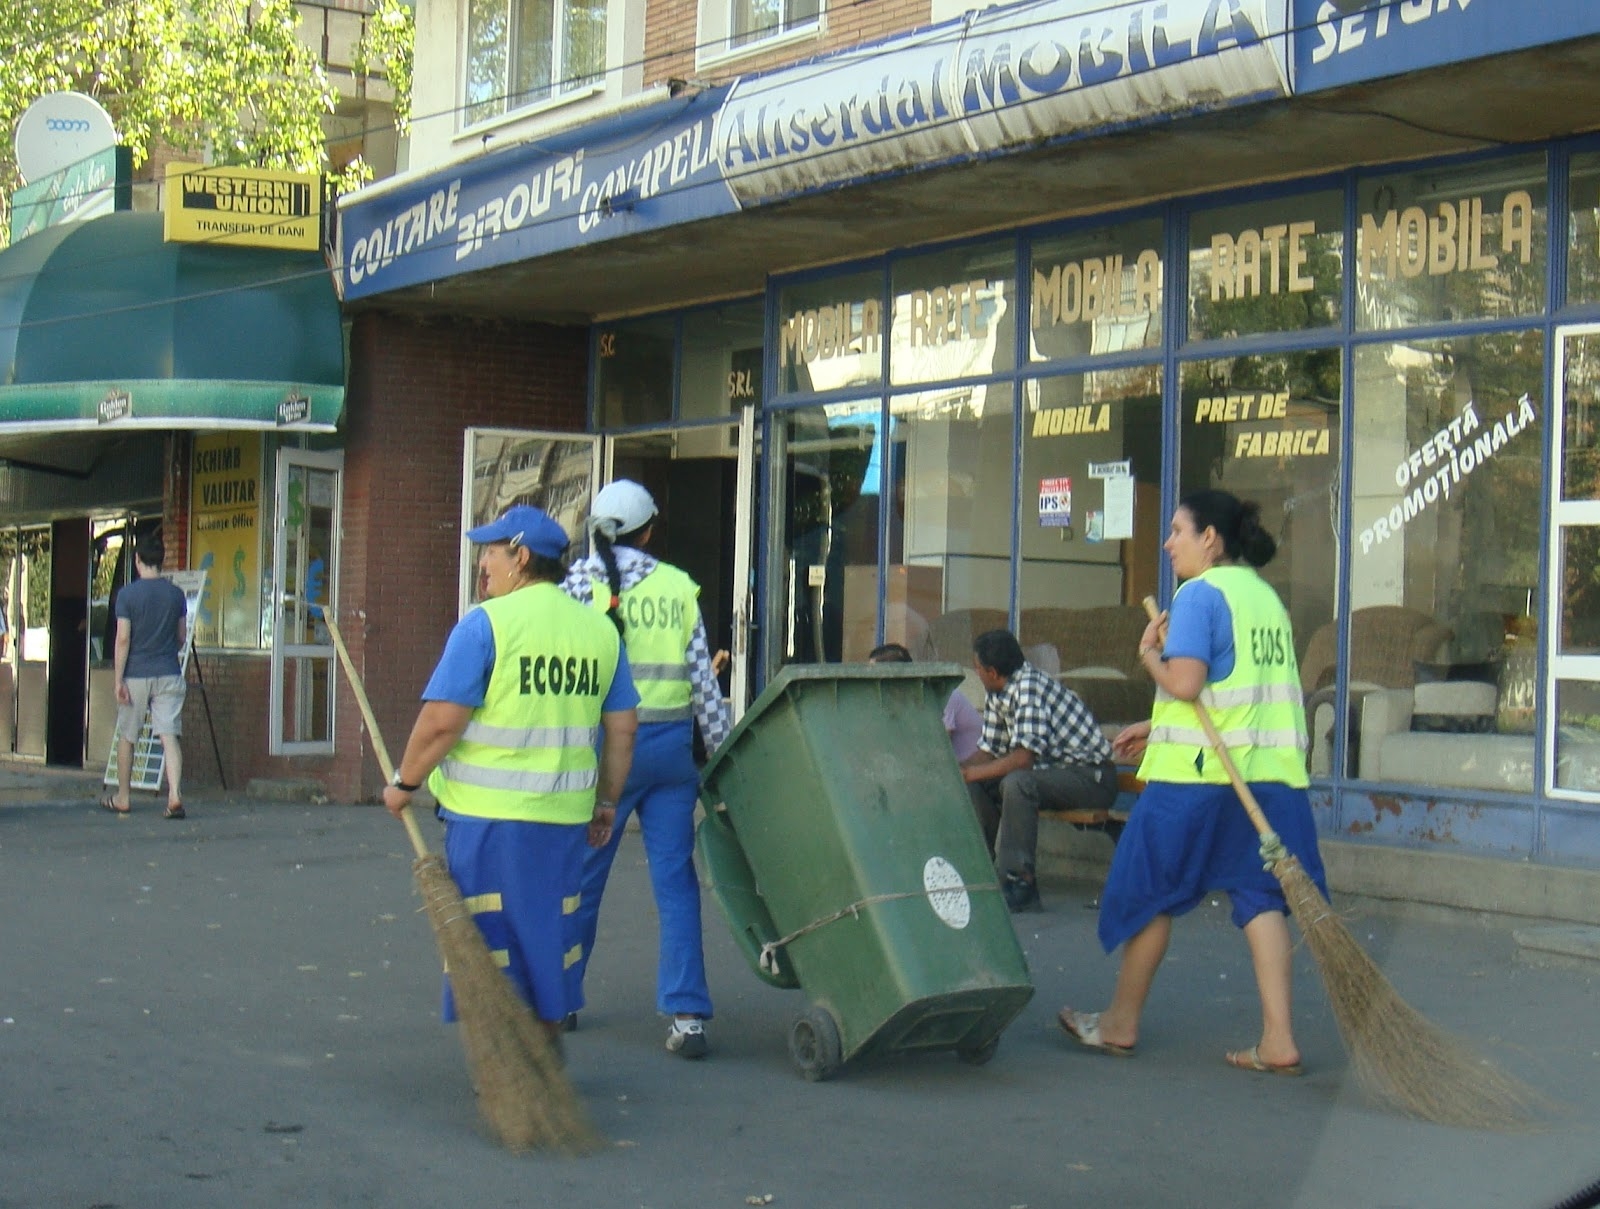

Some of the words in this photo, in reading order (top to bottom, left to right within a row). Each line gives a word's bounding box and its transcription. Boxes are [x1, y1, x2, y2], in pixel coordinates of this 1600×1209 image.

[184, 174, 290, 198] WESTERN
[215, 194, 290, 215] UNION
[260, 223, 274, 235] DE
[278, 226, 305, 238] BANI
[350, 179, 461, 285] COLTARE
[1361, 190, 1532, 283] MOBILA
[1211, 220, 1316, 303] RATE
[1032, 248, 1159, 329] MOBILA
[910, 278, 988, 348] RATE
[780, 298, 879, 368] MOBILA
[1195, 394, 1255, 424] PRET
[1258, 392, 1290, 419] DE
[196, 447, 241, 473] SCHIMB
[203, 479, 256, 505] VALUTAR
[1040, 495, 1059, 510] IPS
[519, 654, 600, 696] ECOSAL
